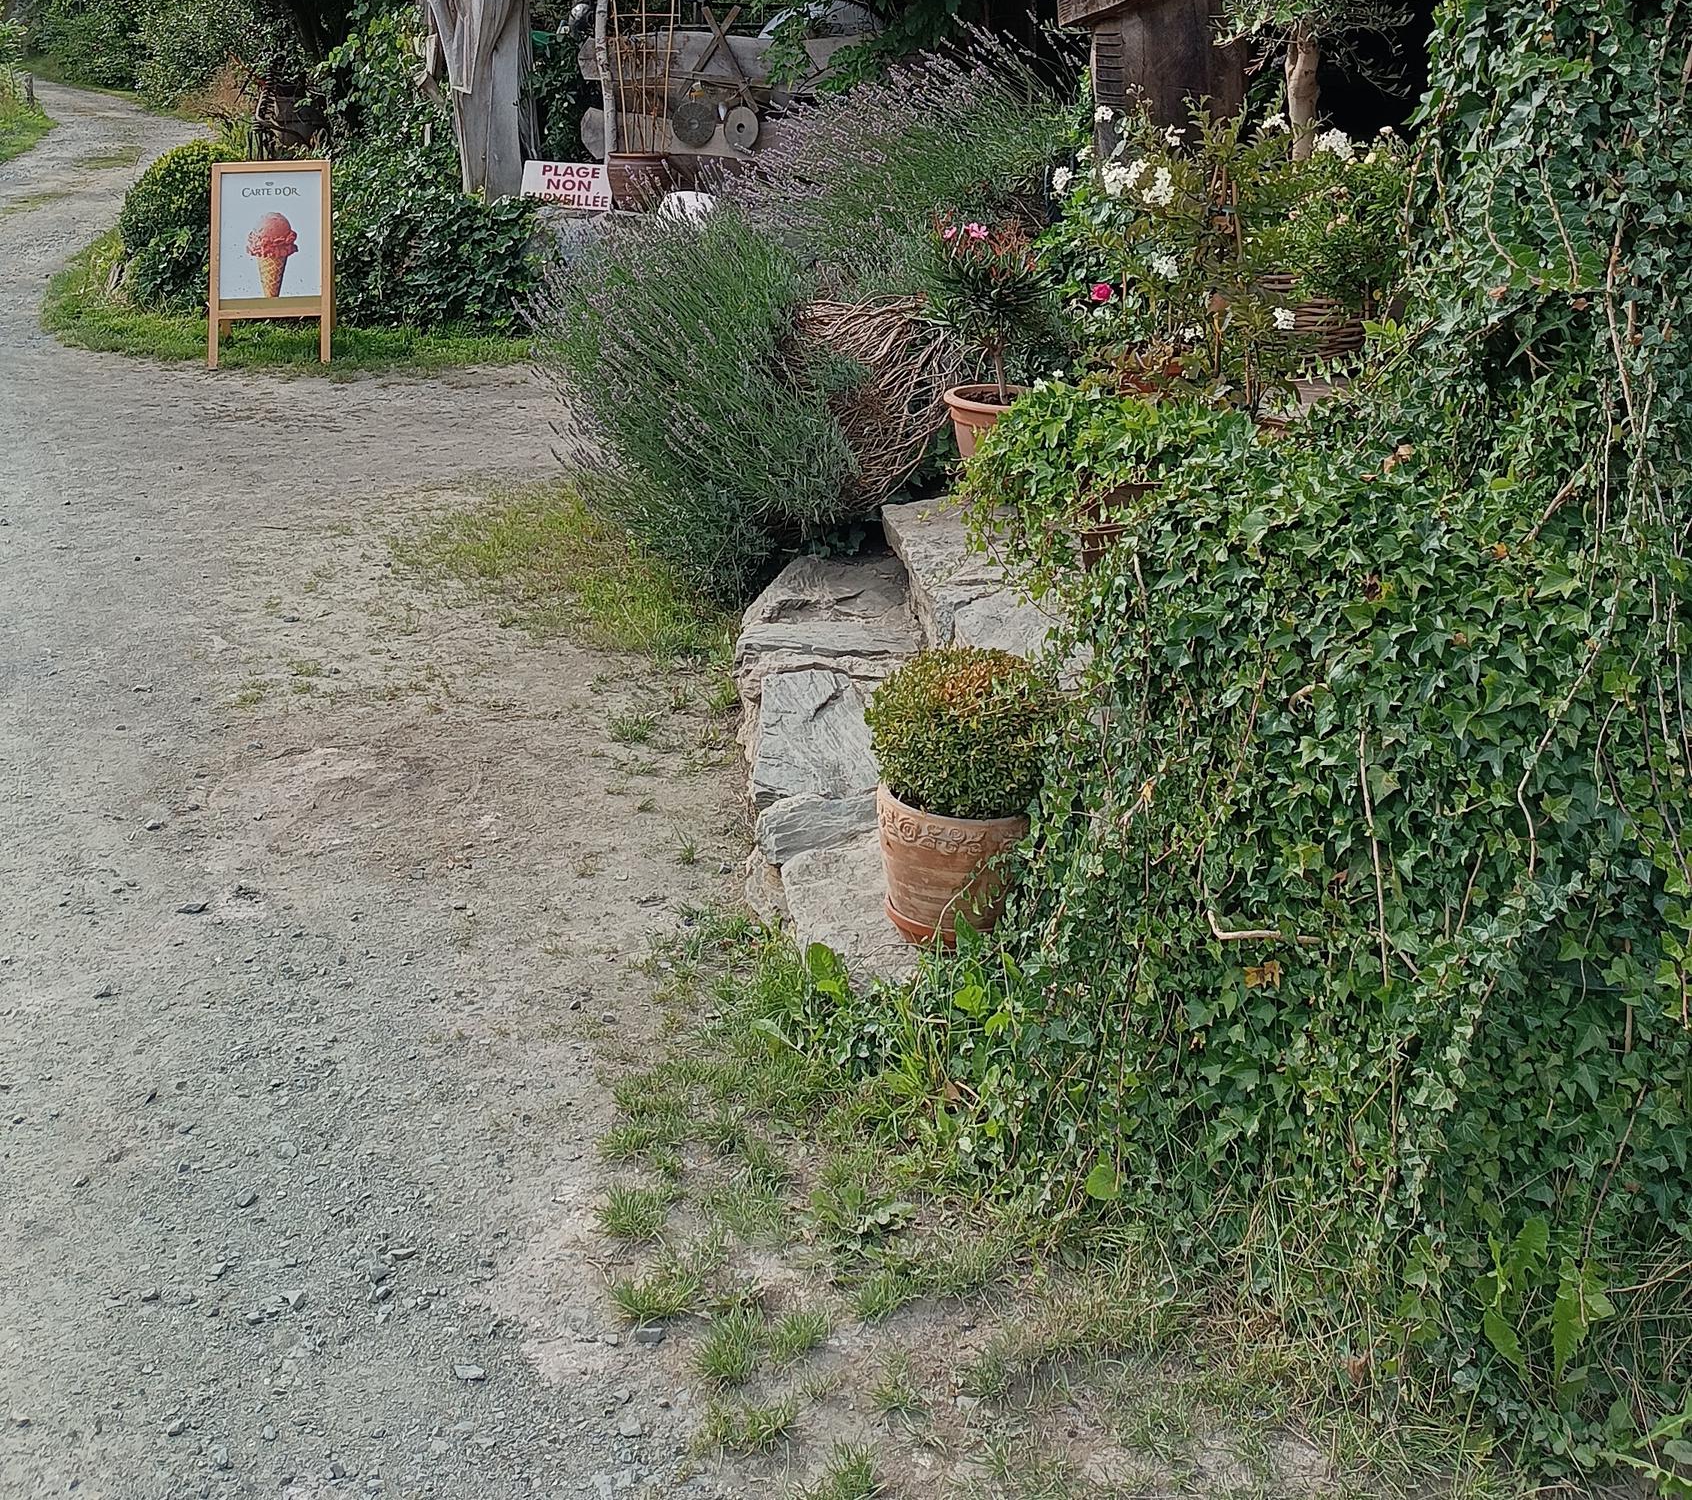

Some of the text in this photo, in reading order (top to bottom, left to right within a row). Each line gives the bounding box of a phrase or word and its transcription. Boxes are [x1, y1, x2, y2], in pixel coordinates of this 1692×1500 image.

[542, 164, 601, 179] PLAGE
[546, 178, 592, 192] NON
[242, 187, 272, 198] CARTE
